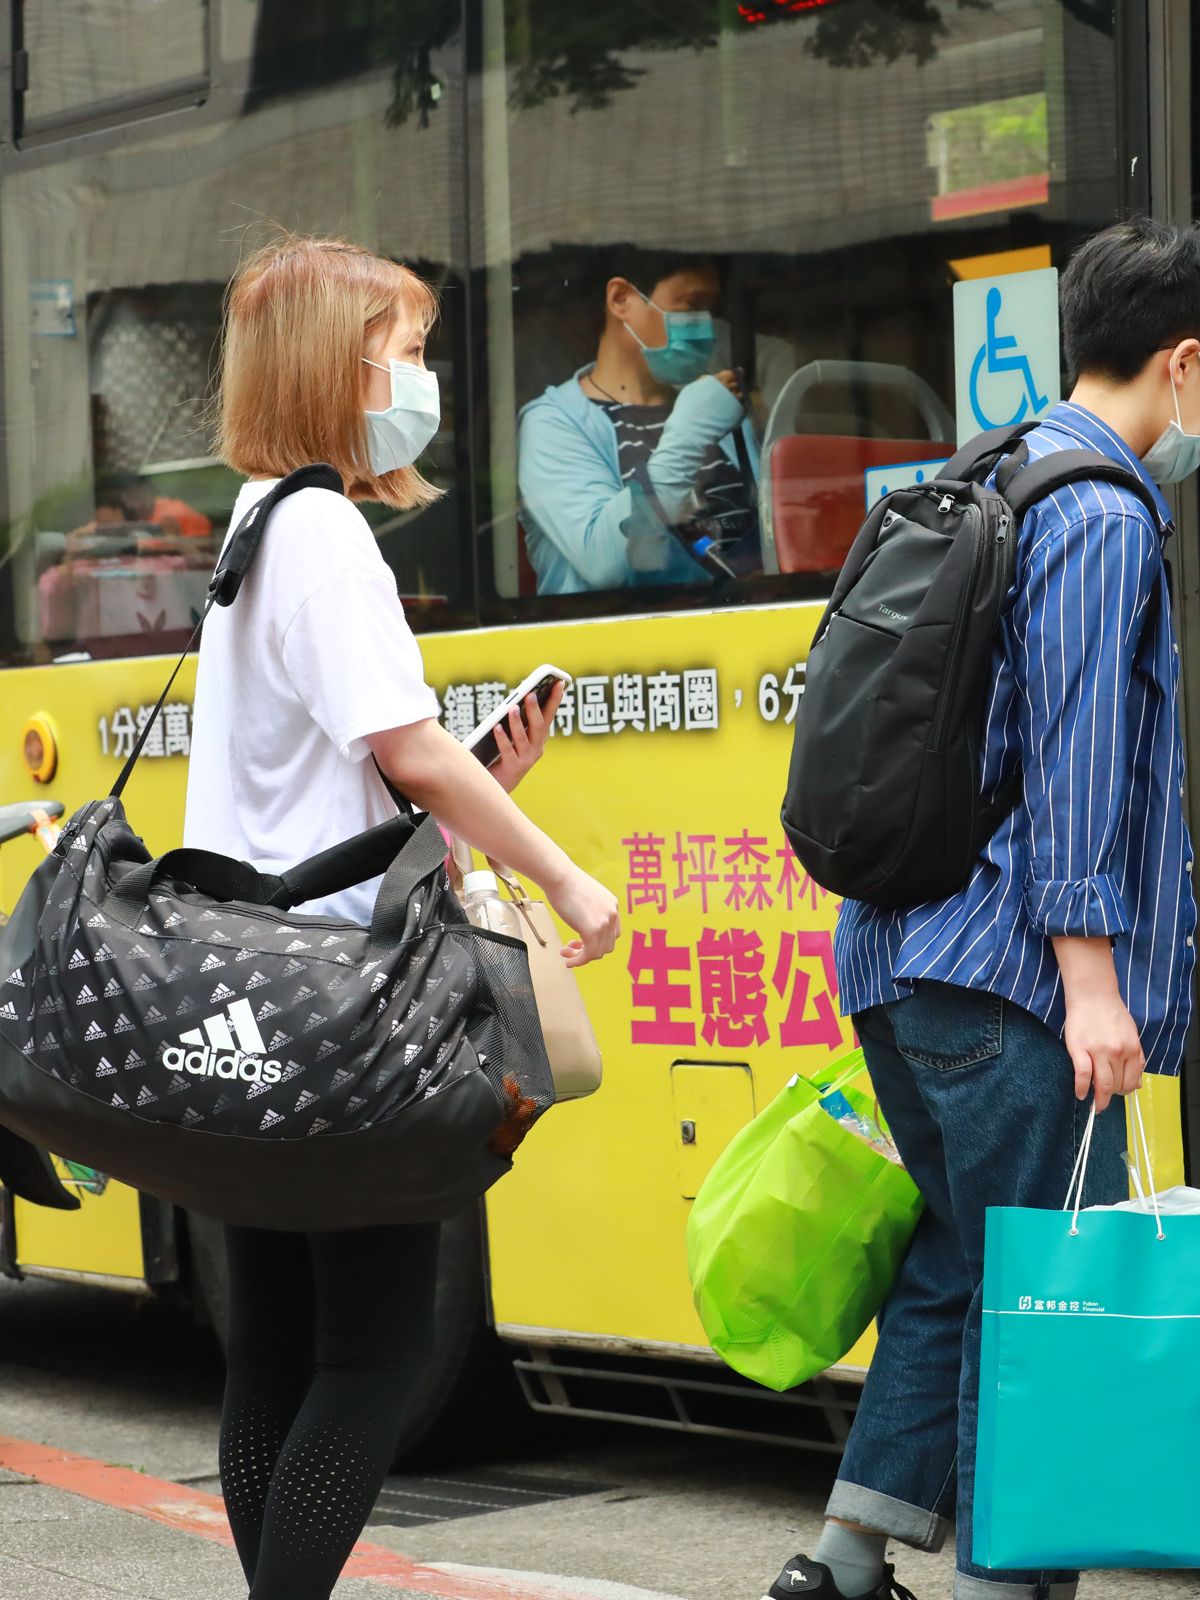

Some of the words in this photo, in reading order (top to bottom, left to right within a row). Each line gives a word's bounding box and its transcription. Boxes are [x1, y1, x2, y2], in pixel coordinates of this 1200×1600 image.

[878, 603, 909, 620] Targus
[68, 959, 90, 970] adidas
[94, 953, 117, 963] adidas
[200, 960, 226, 973] adidas
[282, 964, 307, 978] adidas
[133, 982, 158, 991] adidas
[245, 978, 271, 991] adidas
[76, 995, 98, 1006] adidas
[210, 990, 236, 1004] adidas
[291, 990, 318, 1005] adidas
[143, 1015, 167, 1026] adidas
[256, 1006, 282, 1022] adidas
[114, 1023, 136, 1034] adidas
[303, 1016, 328, 1034] adidas
[84, 1031, 108, 1042] adidas
[268, 1036, 294, 1052] adidas
[404, 1045, 423, 1066] adidas
[125, 1060, 147, 1071] adidas
[162, 1045, 282, 1083] adidas
[96, 1066, 118, 1078] adidas
[281, 1065, 306, 1083] adidas
[329, 1072, 355, 1091] adidas
[246, 1084, 273, 1100] adidas
[136, 1094, 159, 1107] adidas
[294, 1094, 320, 1112] adidas
[259, 1114, 286, 1131] adidas
[1034, 1300, 1080, 1312] 富邦金控
